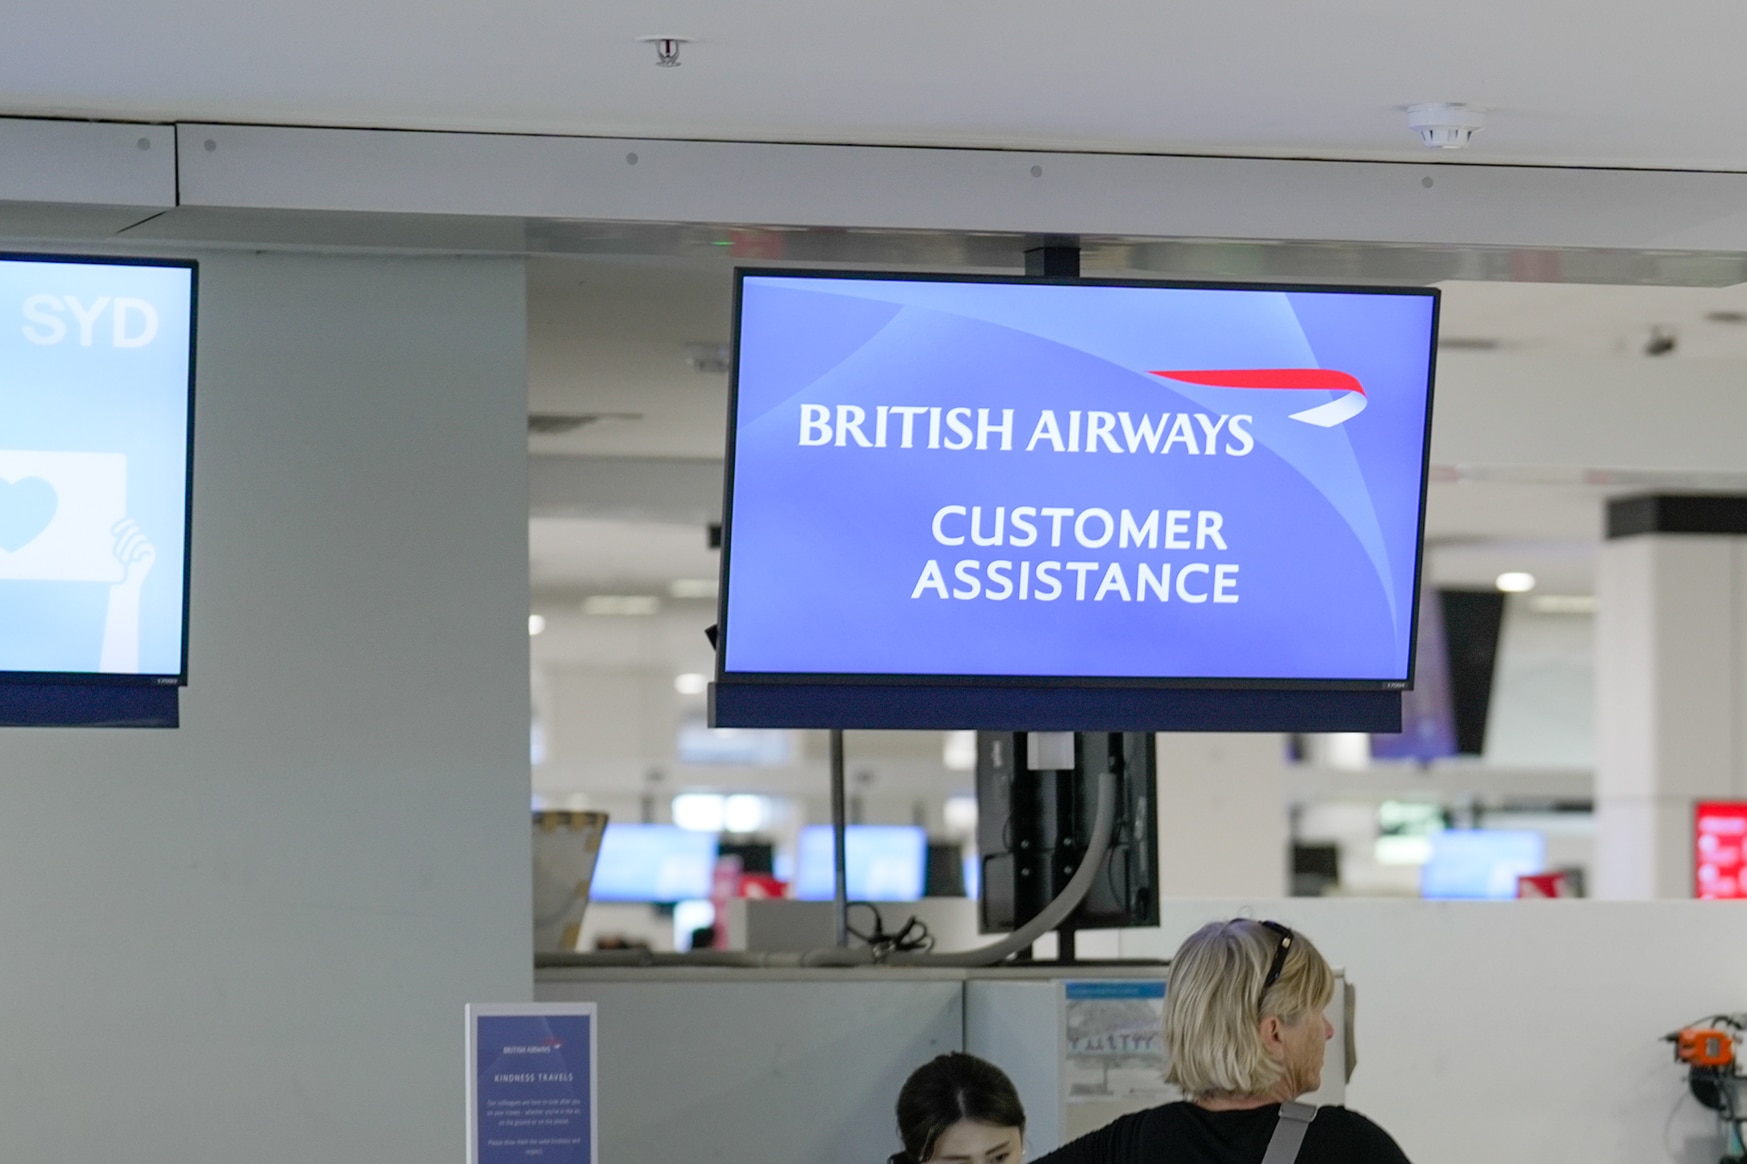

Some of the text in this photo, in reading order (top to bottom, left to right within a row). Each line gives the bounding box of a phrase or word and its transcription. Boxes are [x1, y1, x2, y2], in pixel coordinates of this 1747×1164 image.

[21, 294, 159, 349] SYD
[798, 403, 1255, 457] BRITISH AIRWAYS
[931, 504, 1228, 552] CUSTOMER
[911, 559, 1240, 605] ASSISTANCE
[494, 1071, 573, 1083] KINDNESS TRAVELS
